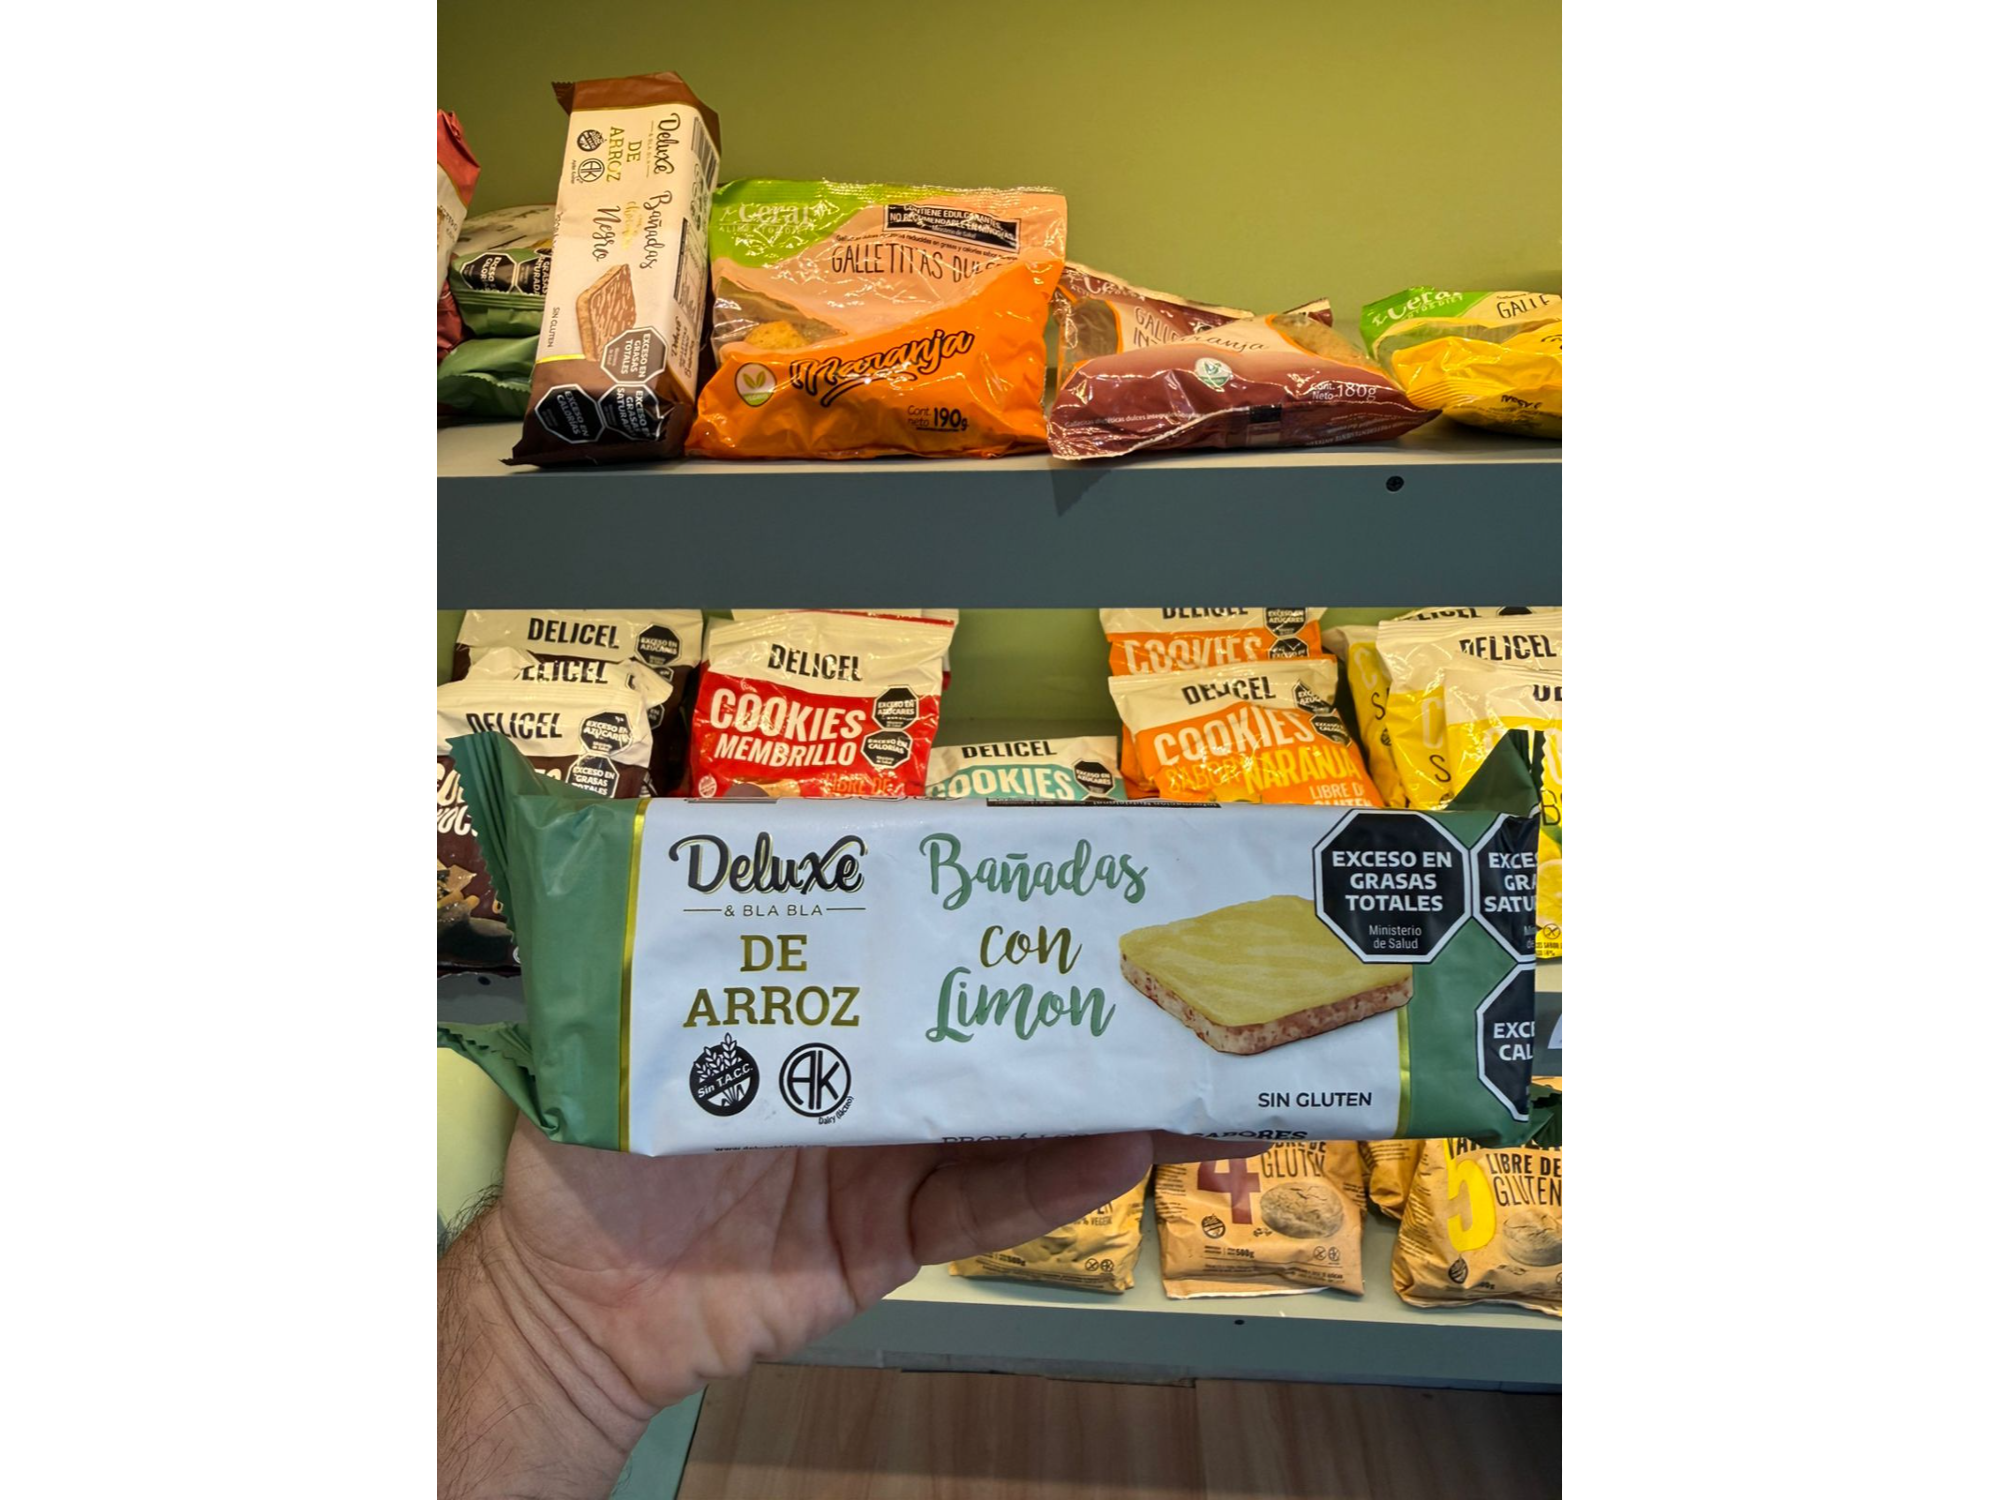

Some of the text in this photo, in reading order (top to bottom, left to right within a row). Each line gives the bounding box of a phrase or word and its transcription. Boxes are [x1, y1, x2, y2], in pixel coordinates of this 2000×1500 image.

[606, 126, 625, 182] ARROZ
[626, 140, 642, 163] DE
[654, 112, 681, 175] Deluxe
[592, 206, 621, 262] Negro
[640, 190, 673, 269] Bañadas
[831, 243, 944, 279] GALLETITAS
[547, 306, 560, 348] SIN GLUTEN
[620, 339, 633, 375] TOTALES
[630, 340, 641, 373] GRASAS
[638, 333, 651, 378] EXCESO EN
[790, 329, 975, 396] Naranja
[564, 390, 584, 424] EXCESO
[636, 390, 648, 427] EXCESO
[1336, 382, 1377, 402] 180g
[934, 406, 969, 432] 190g
[1126, 414, 1146, 422] dulces
[527, 617, 620, 650] DELICEL
[1459, 634, 1557, 661] DELICEL
[767, 643, 863, 682] DELICEL
[1123, 633, 1263, 675] COOKIES
[521, 659, 609, 684] ELICEL
[466, 712, 563, 739] DELICEL
[585, 720, 618, 732] EXCESO
[710, 688, 866, 742] COOKIES
[714, 733, 857, 768] MEMBRILLO
[961, 740, 1058, 759] DELICEL
[1153, 703, 1316, 767] COOKIES
[572, 766, 615, 780] EXCESO EN
[575, 774, 608, 787] GRASAS
[930, 767, 1076, 801] COOKIES
[1242, 746, 1363, 795] NARANJA
[1309, 782, 1350, 800] LIBRE
[669, 832, 869, 895] Deluxe
[919, 832, 1149, 911] Bañadas
[1331, 850, 1453, 868] EXCESO EN
[1350, 873, 1437, 891] GRASAS
[723, 903, 823, 917] & BLA BLA
[1345, 894, 1444, 912] TOTALES
[1369, 924, 1422, 937] Ministerio
[1373, 937, 1418, 950] de Salud
[740, 934, 808, 972] DE
[979, 924, 1083, 975] con
[682, 986, 861, 1028] ARROZ
[925, 966, 1116, 1043] Limon
[697, 1084, 716, 1098] Sin
[1258, 1092, 1373, 1108] SIN GLUTEN
[818, 1116, 836, 1125] Dairy
[1485, 1153, 1562, 1179] LIBRE DE
[1197, 1159, 1261, 1225] 4
[1443, 1138, 1496, 1252] 5
[1493, 1175, 1562, 1207] GLUTEN
